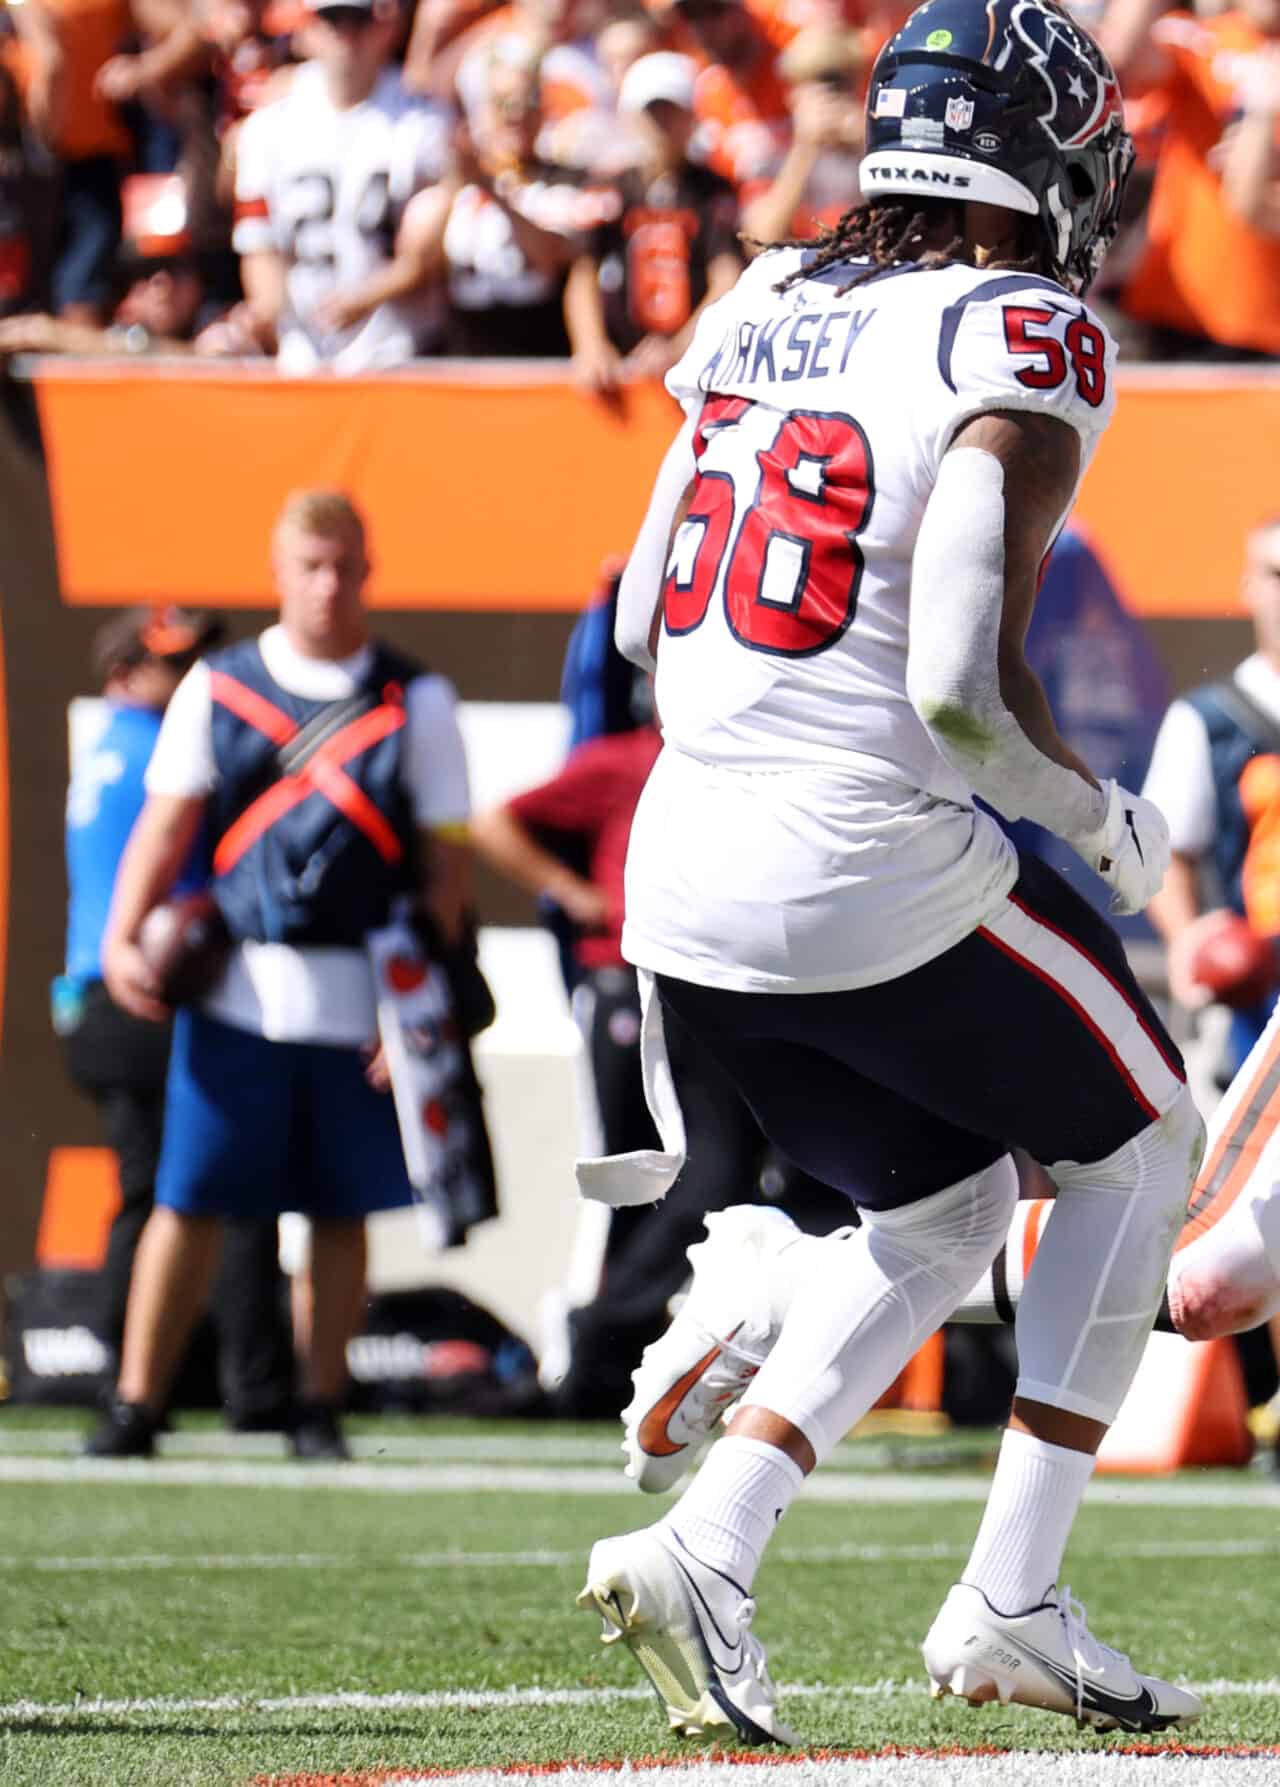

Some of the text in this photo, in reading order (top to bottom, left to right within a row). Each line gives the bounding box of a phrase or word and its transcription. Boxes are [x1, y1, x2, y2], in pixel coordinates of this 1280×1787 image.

[869, 167, 971, 187] TEXANS
[1001, 305, 1105, 408] 58
[664, 391, 876, 659] 58
